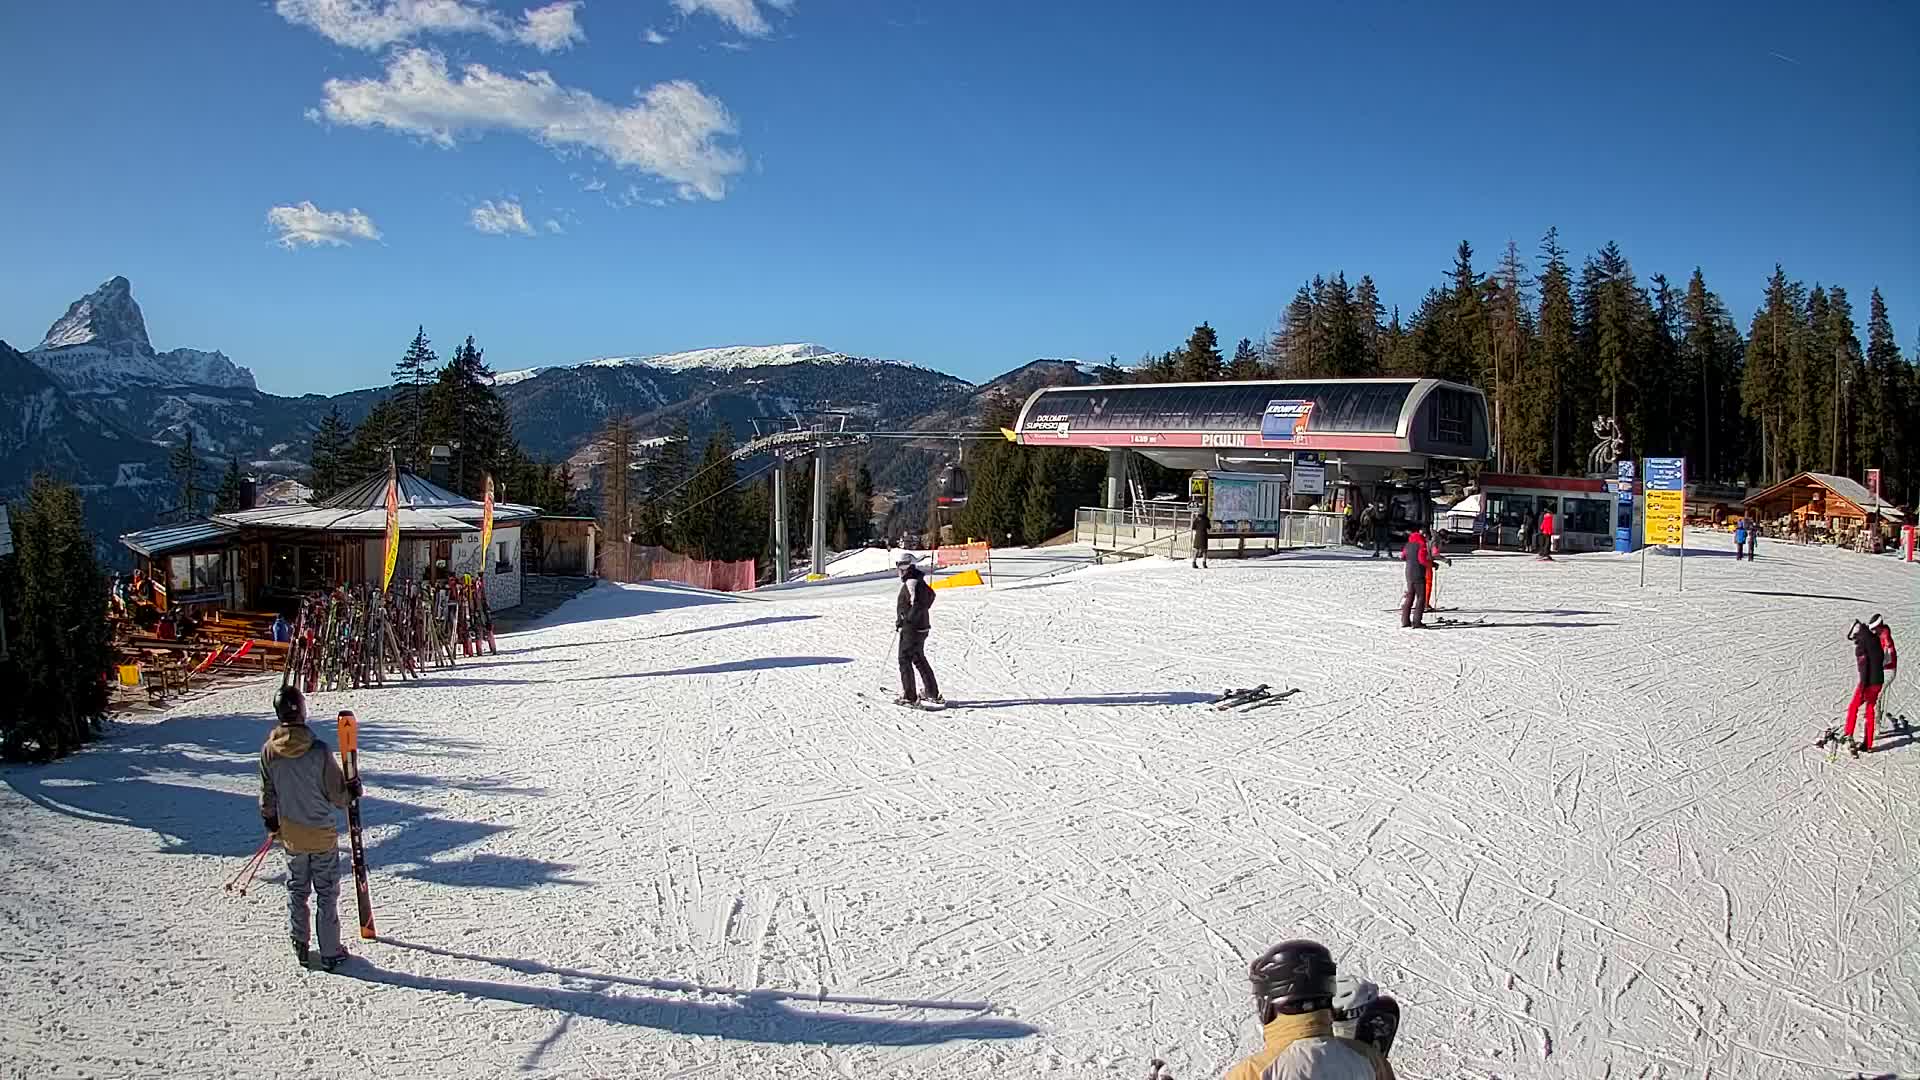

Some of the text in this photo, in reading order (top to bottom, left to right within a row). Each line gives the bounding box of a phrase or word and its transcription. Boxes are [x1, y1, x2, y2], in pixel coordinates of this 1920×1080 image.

[1036, 414, 1069, 422] DOLOMITI
[1025, 422, 1059, 430] SUPERSKI
[1201, 434, 1245, 447] PICULIN
